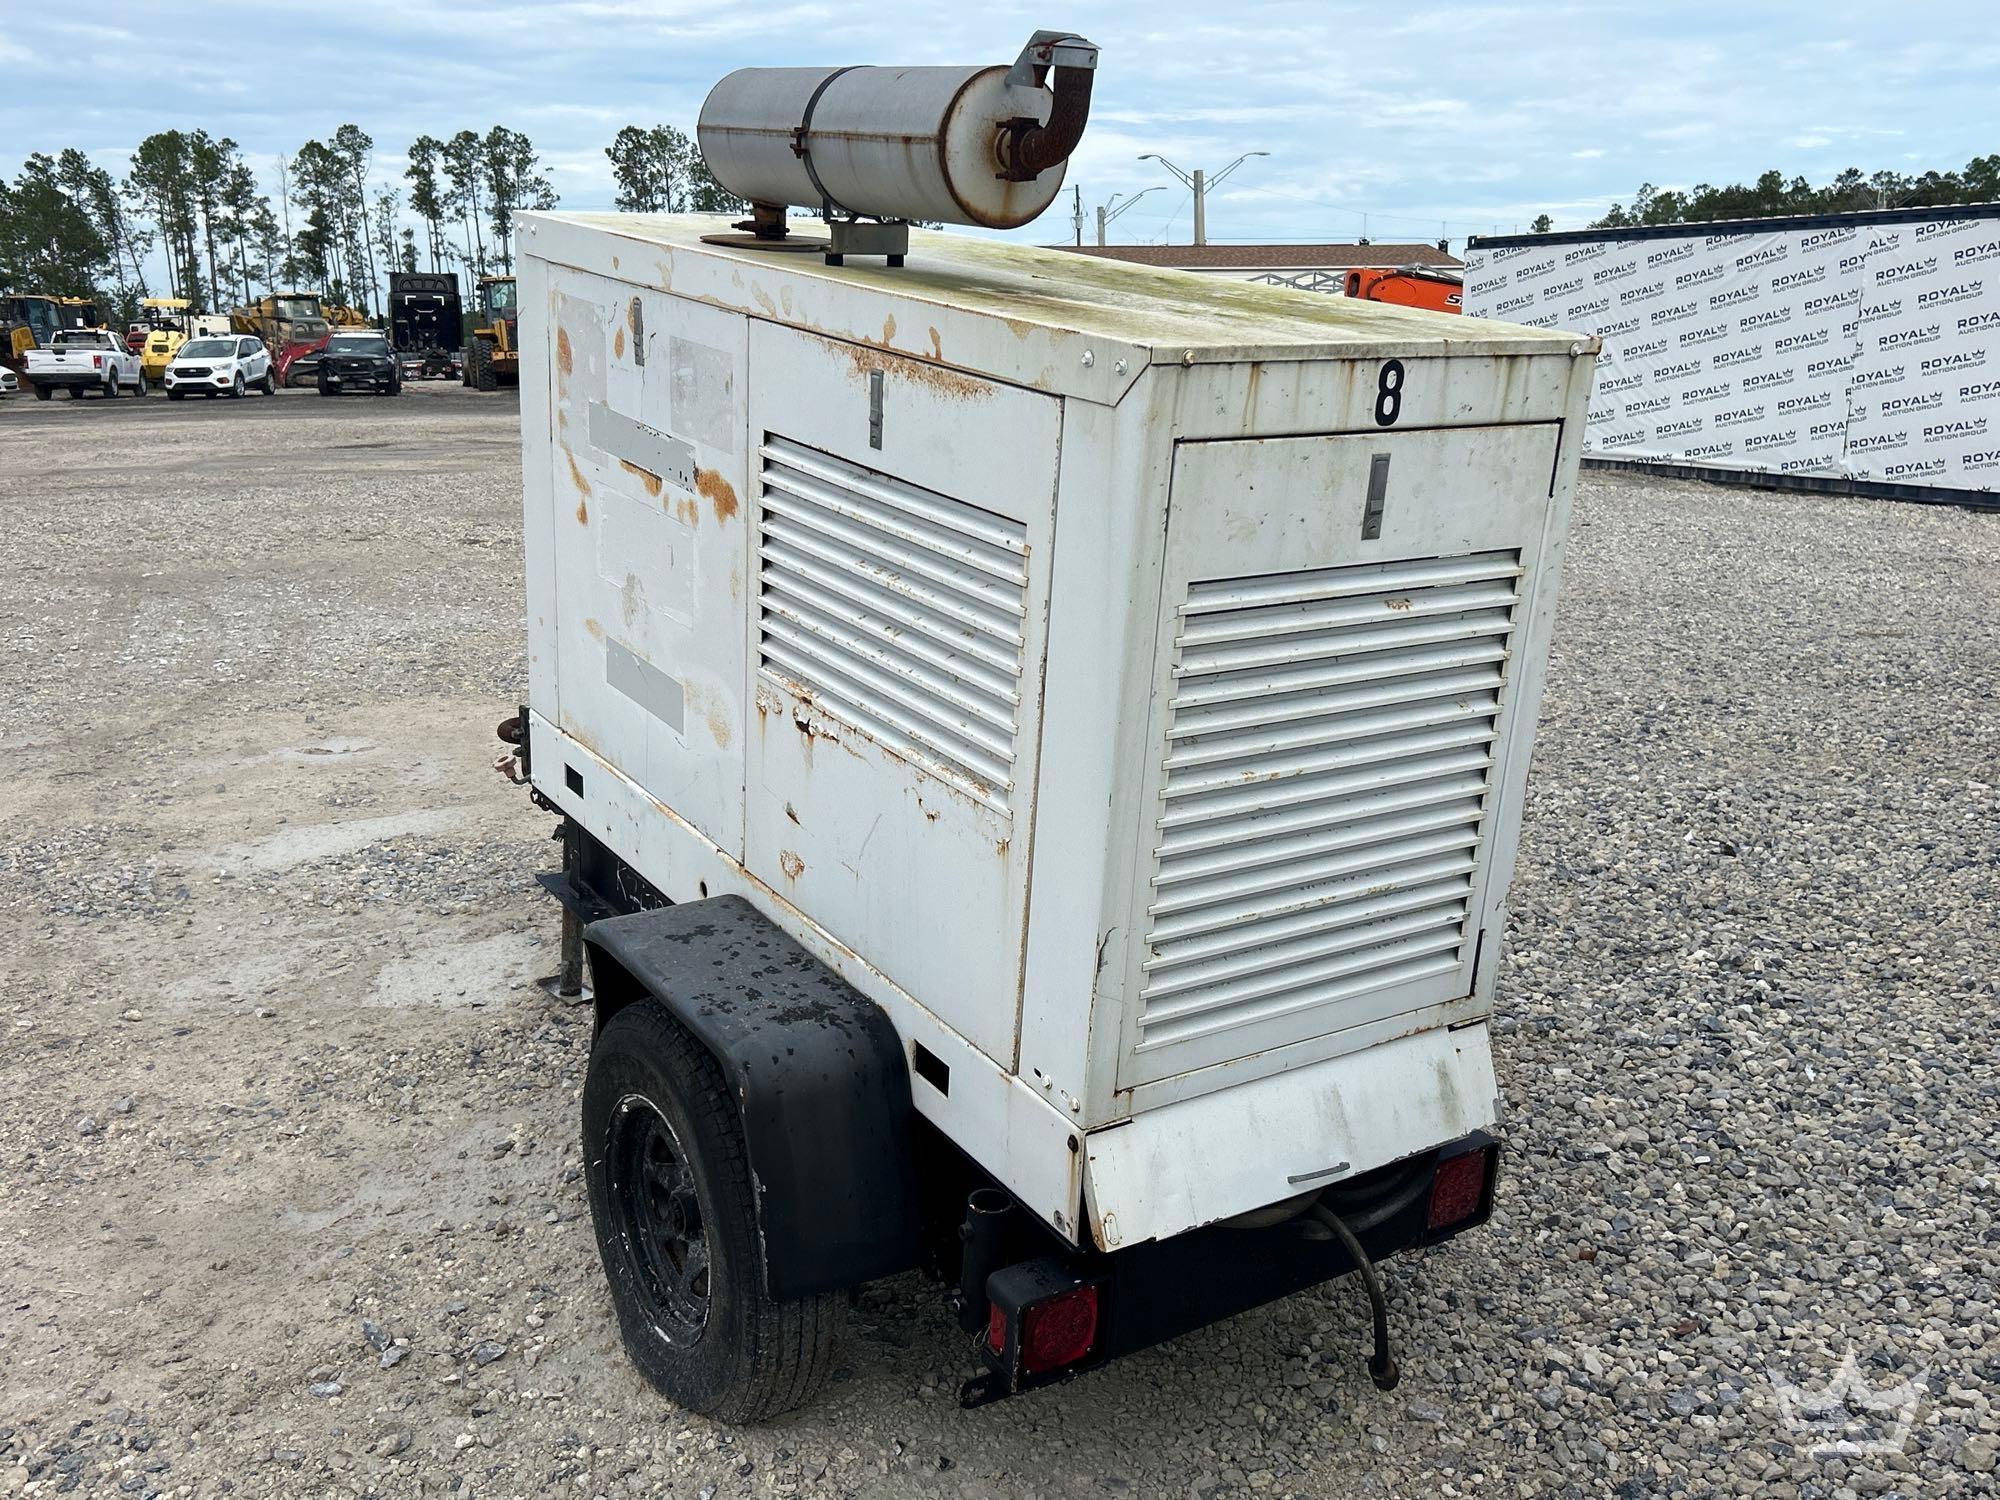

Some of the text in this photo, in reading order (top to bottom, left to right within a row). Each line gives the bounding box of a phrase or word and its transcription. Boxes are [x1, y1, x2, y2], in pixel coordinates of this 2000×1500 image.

[1801, 228, 1844, 247] ROYAL
[1916, 221, 1979, 243] AUCTION GROUP
[1802, 240, 1831, 254] AUCTION
[1833, 233, 1857, 245] GROUP
[1874, 243, 1900, 255] GROUP
[1954, 240, 1999, 260] ROYA
[1565, 245, 1597, 262] ROYAL
[1647, 247, 1683, 264] ROYAL
[1673, 251, 1693, 262] GROUP
[1736, 249, 1776, 267] ROYAL
[1839, 253, 1865, 268] ROY
[1955, 253, 1990, 267] AUCTION
[1516, 262, 1546, 278] ROYAL
[1737, 253, 1788, 273] AUCTION GROUP
[1840, 263, 1865, 275] AUCTIO
[1876, 261, 1923, 280] ROYAL
[1593, 264, 1627, 280] ROYAL
[1676, 267, 1713, 284] ROYAL
[1772, 269, 1813, 287] ROYAL
[1877, 267, 1937, 287] AUCTION GROUP
[1471, 278, 1499, 293] ROYAL
[1543, 280, 1574, 296] ROYAL
[1677, 272, 1724, 290] AUCTION GROUP
[1773, 275, 1826, 293] AUCTION GROUP
[1446, 294, 1463, 306] S
[1620, 285, 1654, 301] ROYAL
[1709, 288, 1748, 305] ROYAL
[1918, 284, 1968, 303] ROYAL
[1919, 290, 1982, 310] AUCTION GROUP
[1496, 296, 1525, 310] ROYAL
[1568, 300, 1600, 316] ROYAL
[1710, 293, 1759, 311] AUCTION GROUP
[1804, 292, 1847, 310] ROYAL
[1805, 298, 1860, 316] AUCTION GROUP
[1651, 305, 1686, 321] ROYAL
[1677, 310, 1697, 319] GROUP
[1740, 310, 1779, 327] ROYAL
[1876, 309, 1902, 320] GROUP
[1958, 312, 2000, 328] ROYA
[1597, 320, 1630, 335] ROYAL
[1740, 315, 1791, 333] AUCTION GROUP
[1959, 323, 1993, 335] AUCTION
[1680, 327, 1716, 342] ROYAL
[1680, 332, 1727, 348] AUCTION GROUP
[1775, 332, 1816, 349] ROYAL
[1879, 328, 1926, 345] ROYAL
[1623, 342, 1657, 356] ROYAL
[1776, 338, 1828, 355] AUCTION GROUP
[1880, 334, 1940, 352] AUCTION GROUP
[1713, 348, 1751, 364] ROYAL
[1713, 354, 1762, 369] AUCTION GROUP
[1921, 353, 1971, 370] ROYAL
[1654, 363, 1690, 377] ROYAL
[1807, 356, 1850, 372] ROYAL
[1922, 359, 1985, 376] AUCTION GROUP
[1680, 368, 1700, 377] GROUP
[1742, 371, 1782, 387] ROYAL
[1808, 368, 1837, 378] AUCTION
[1599, 376, 1633, 390] ROYAL
[1743, 377, 1794, 392] AUCTION GROUP
[1852, 375, 1905, 390] UCTION GROUP
[1960, 381, 2000, 396] ROYA
[1375, 359, 1405, 426] 8
[1682, 385, 1719, 400] ROYAL
[1683, 391, 1730, 405] AUCTION GROUP
[1961, 392, 1995, 403] AUCTION
[1626, 398, 1660, 412] ROYAL
[1777, 395, 1819, 410] ROYAL
[1778, 401, 1831, 416] AUCTION GROUP
[1882, 395, 1929, 410] ROYAL
[1883, 401, 1942, 417] AUCTION GROUP
[1587, 410, 1605, 420] YAL
[1715, 408, 1753, 422] ROYAL
[1716, 414, 1764, 428] AUCTION GROUP
[1656, 420, 1692, 434] ROYAL
[1682, 426, 1702, 435] GROUP
[1810, 421, 1845, 434] ROYA
[1923, 421, 1972, 436] ROYAL
[1602, 432, 1635, 444] ROYAL
[1745, 432, 1785, 446] ROYAL
[1811, 431, 1840, 441] AUCTION
[1849, 434, 1894, 448] ROYAL
[1924, 428, 1987, 443] AUCTION GROUP
[1685, 444, 1721, 457] ROYAL
[1746, 439, 1796, 452] AUCTION GROUP
[1850, 441, 1908, 455] AUCTION GROUP
[1712, 450, 1732, 458] GROUP
[1962, 450, 2000, 464] ROYA
[1780, 457, 1822, 470] ROYAL
[1811, 464, 1834, 472] GROUP
[1885, 461, 1932, 475] ROYAL
[1963, 461, 1998, 470] AUCTION
[1886, 468, 1946, 481] AUCTION GROUP
